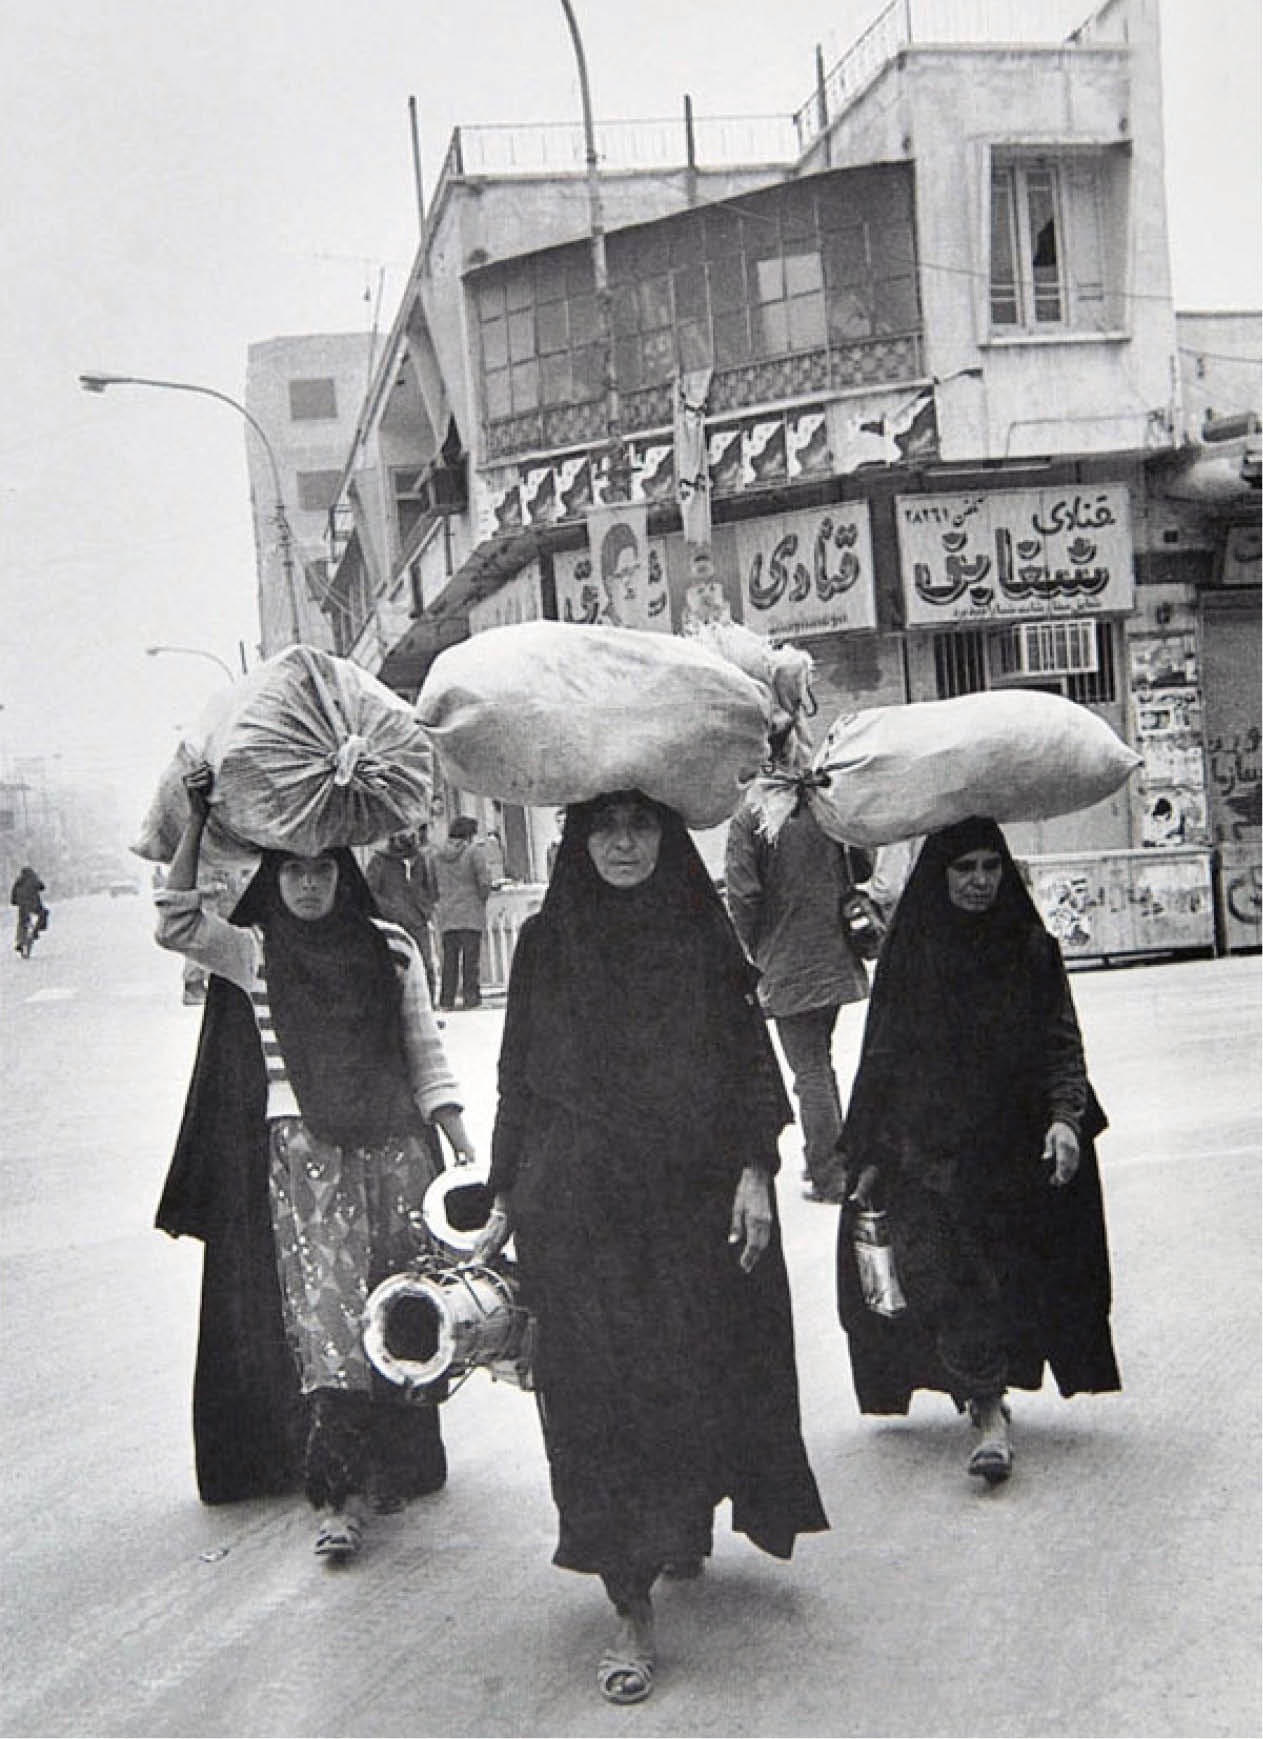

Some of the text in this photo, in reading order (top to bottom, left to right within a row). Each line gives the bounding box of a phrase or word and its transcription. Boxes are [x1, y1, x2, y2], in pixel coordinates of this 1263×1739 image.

[1033, 495, 1116, 535] قنادی
[749, 517, 860, 610] قنادی
[912, 527, 1110, 606] شقایق
